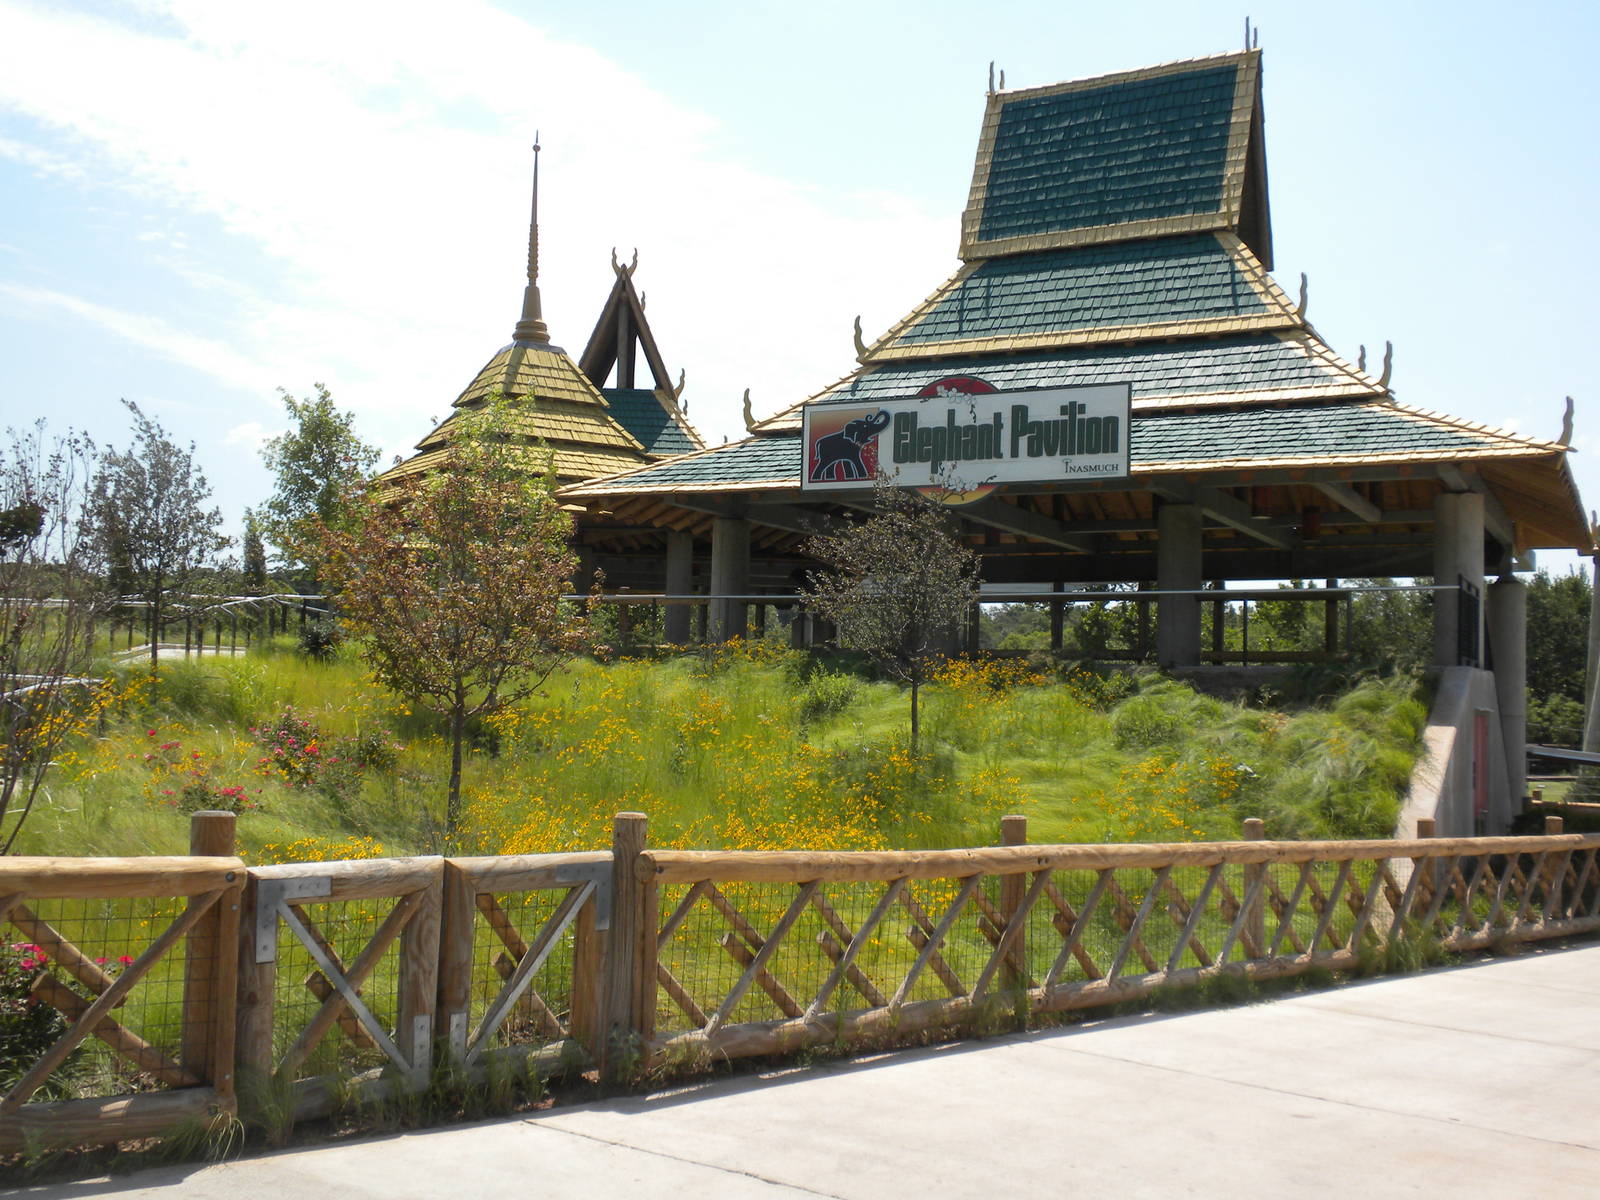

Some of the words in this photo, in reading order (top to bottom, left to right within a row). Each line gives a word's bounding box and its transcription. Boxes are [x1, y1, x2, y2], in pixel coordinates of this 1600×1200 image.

[894, 410, 1003, 474] Elephant
[1011, 402, 1119, 458] Pavilion
[1064, 460, 1119, 473] INASMUCH
